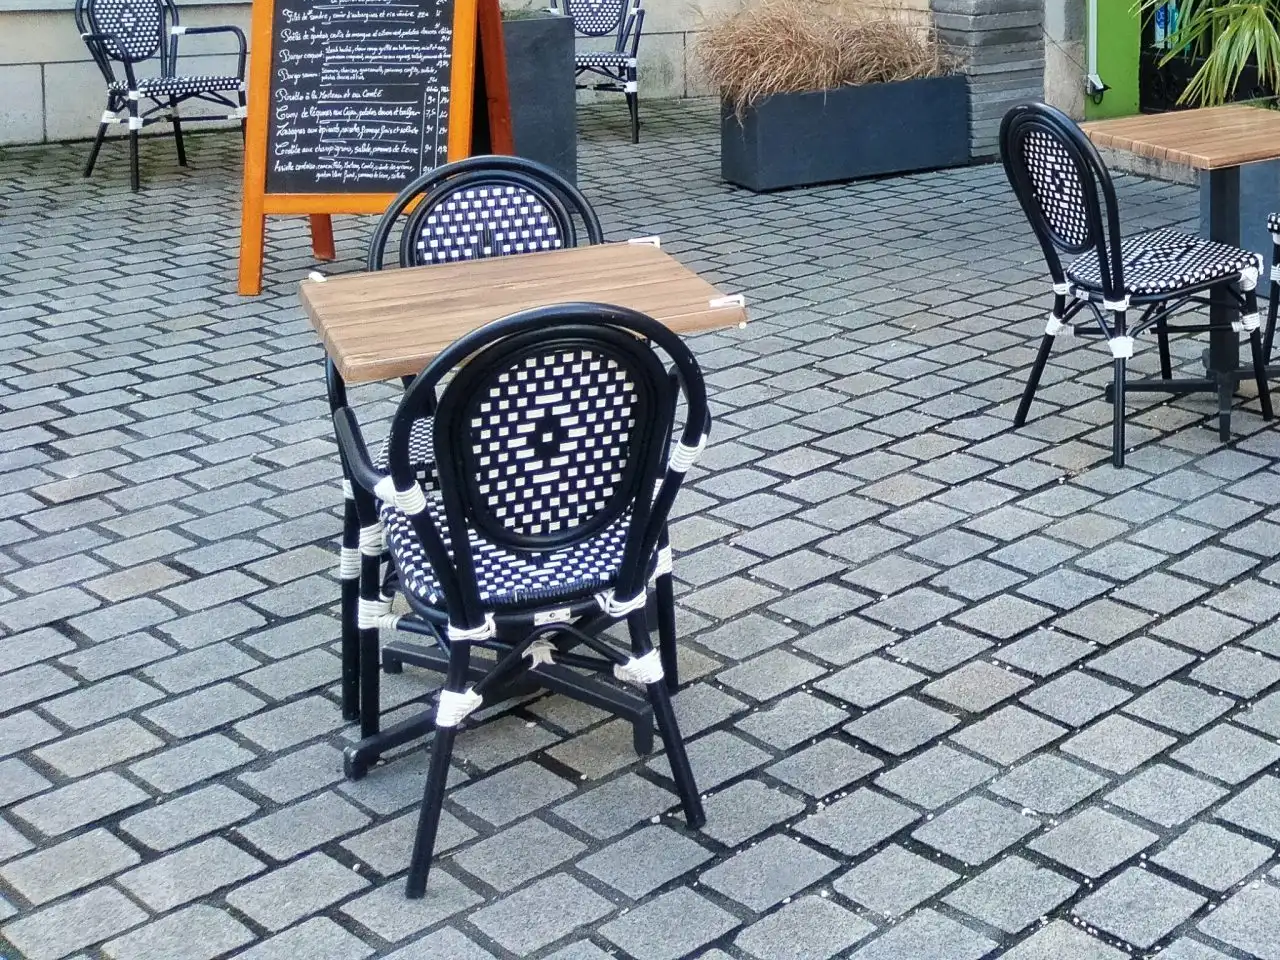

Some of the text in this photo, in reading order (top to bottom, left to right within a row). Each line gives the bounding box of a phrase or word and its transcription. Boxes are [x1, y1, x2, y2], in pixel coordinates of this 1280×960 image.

[303, 30, 309, 40] de
[343, 89, 350, 98] et
[301, 107, 310, 118] de
